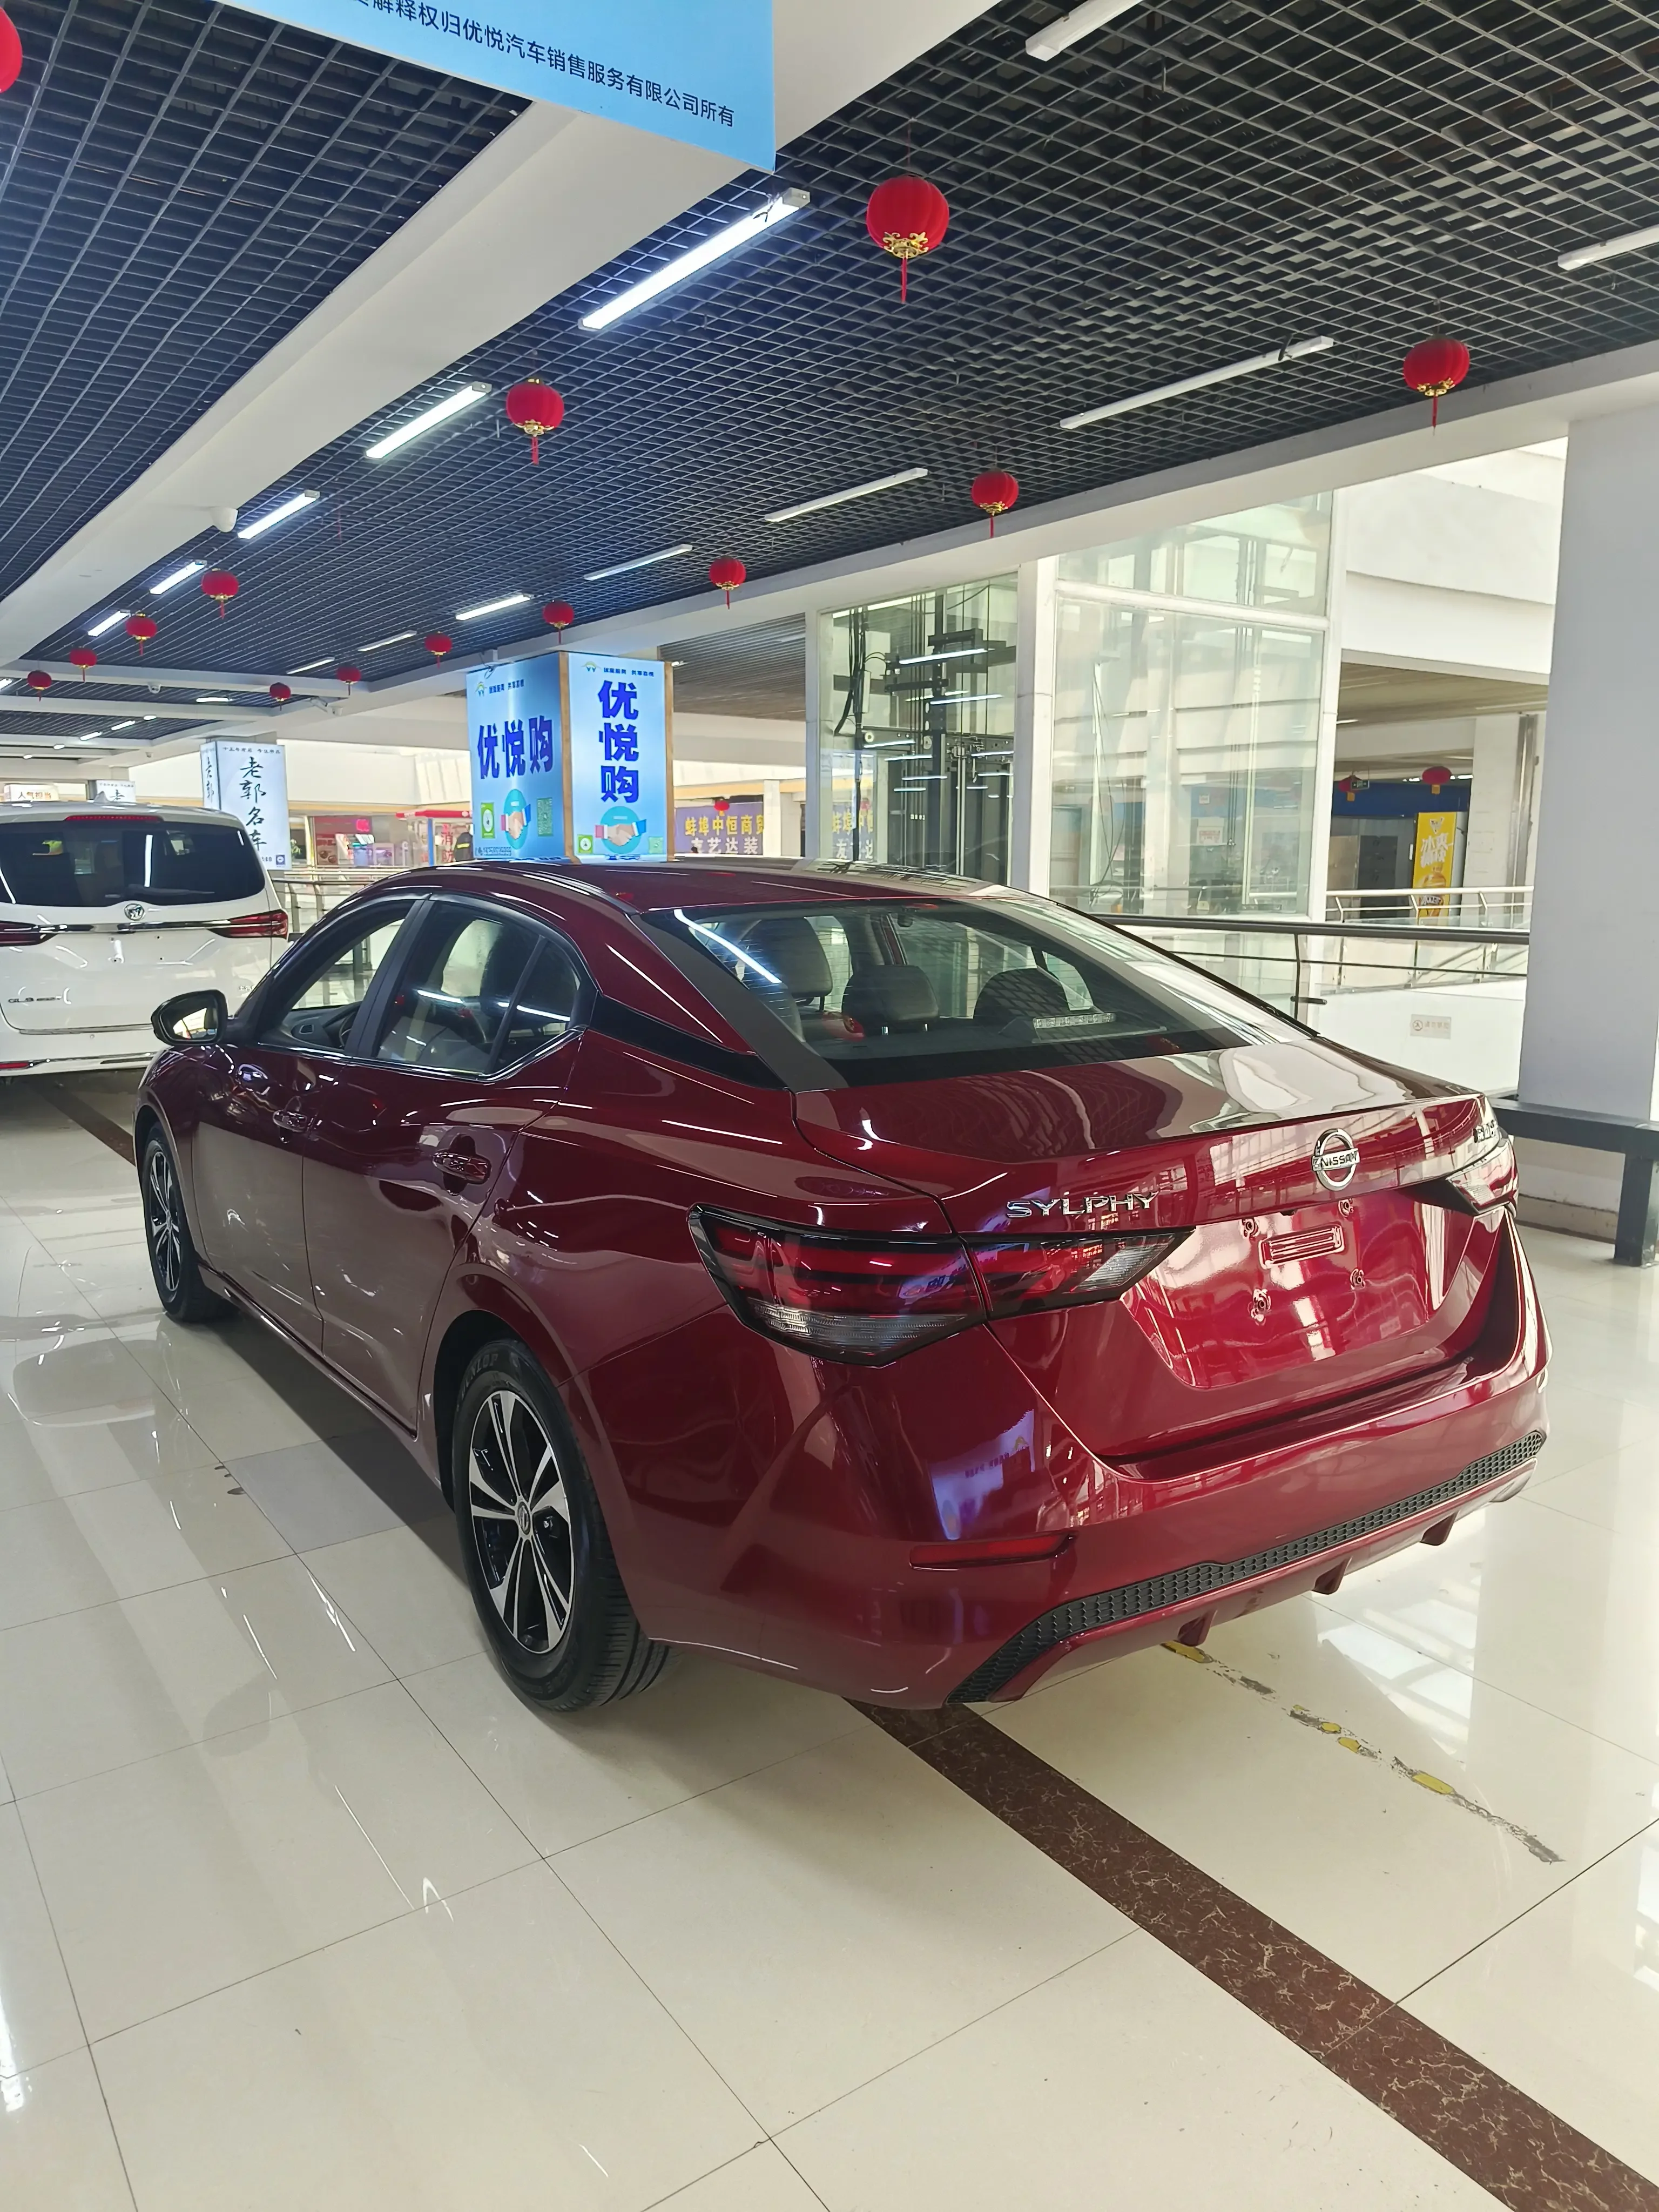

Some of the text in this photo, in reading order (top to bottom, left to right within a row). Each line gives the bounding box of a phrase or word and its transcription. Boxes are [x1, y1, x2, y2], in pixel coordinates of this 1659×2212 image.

[358, 0, 735, 127] 解释权归优悦汽车销售服务有限公司所有
[477, 715, 554, 779] 优悦购
[597, 679, 639, 804] 优悦购
[1320, 1150, 1358, 1167] NISSAN
[1007, 1191, 1159, 1218] SYLPHY
